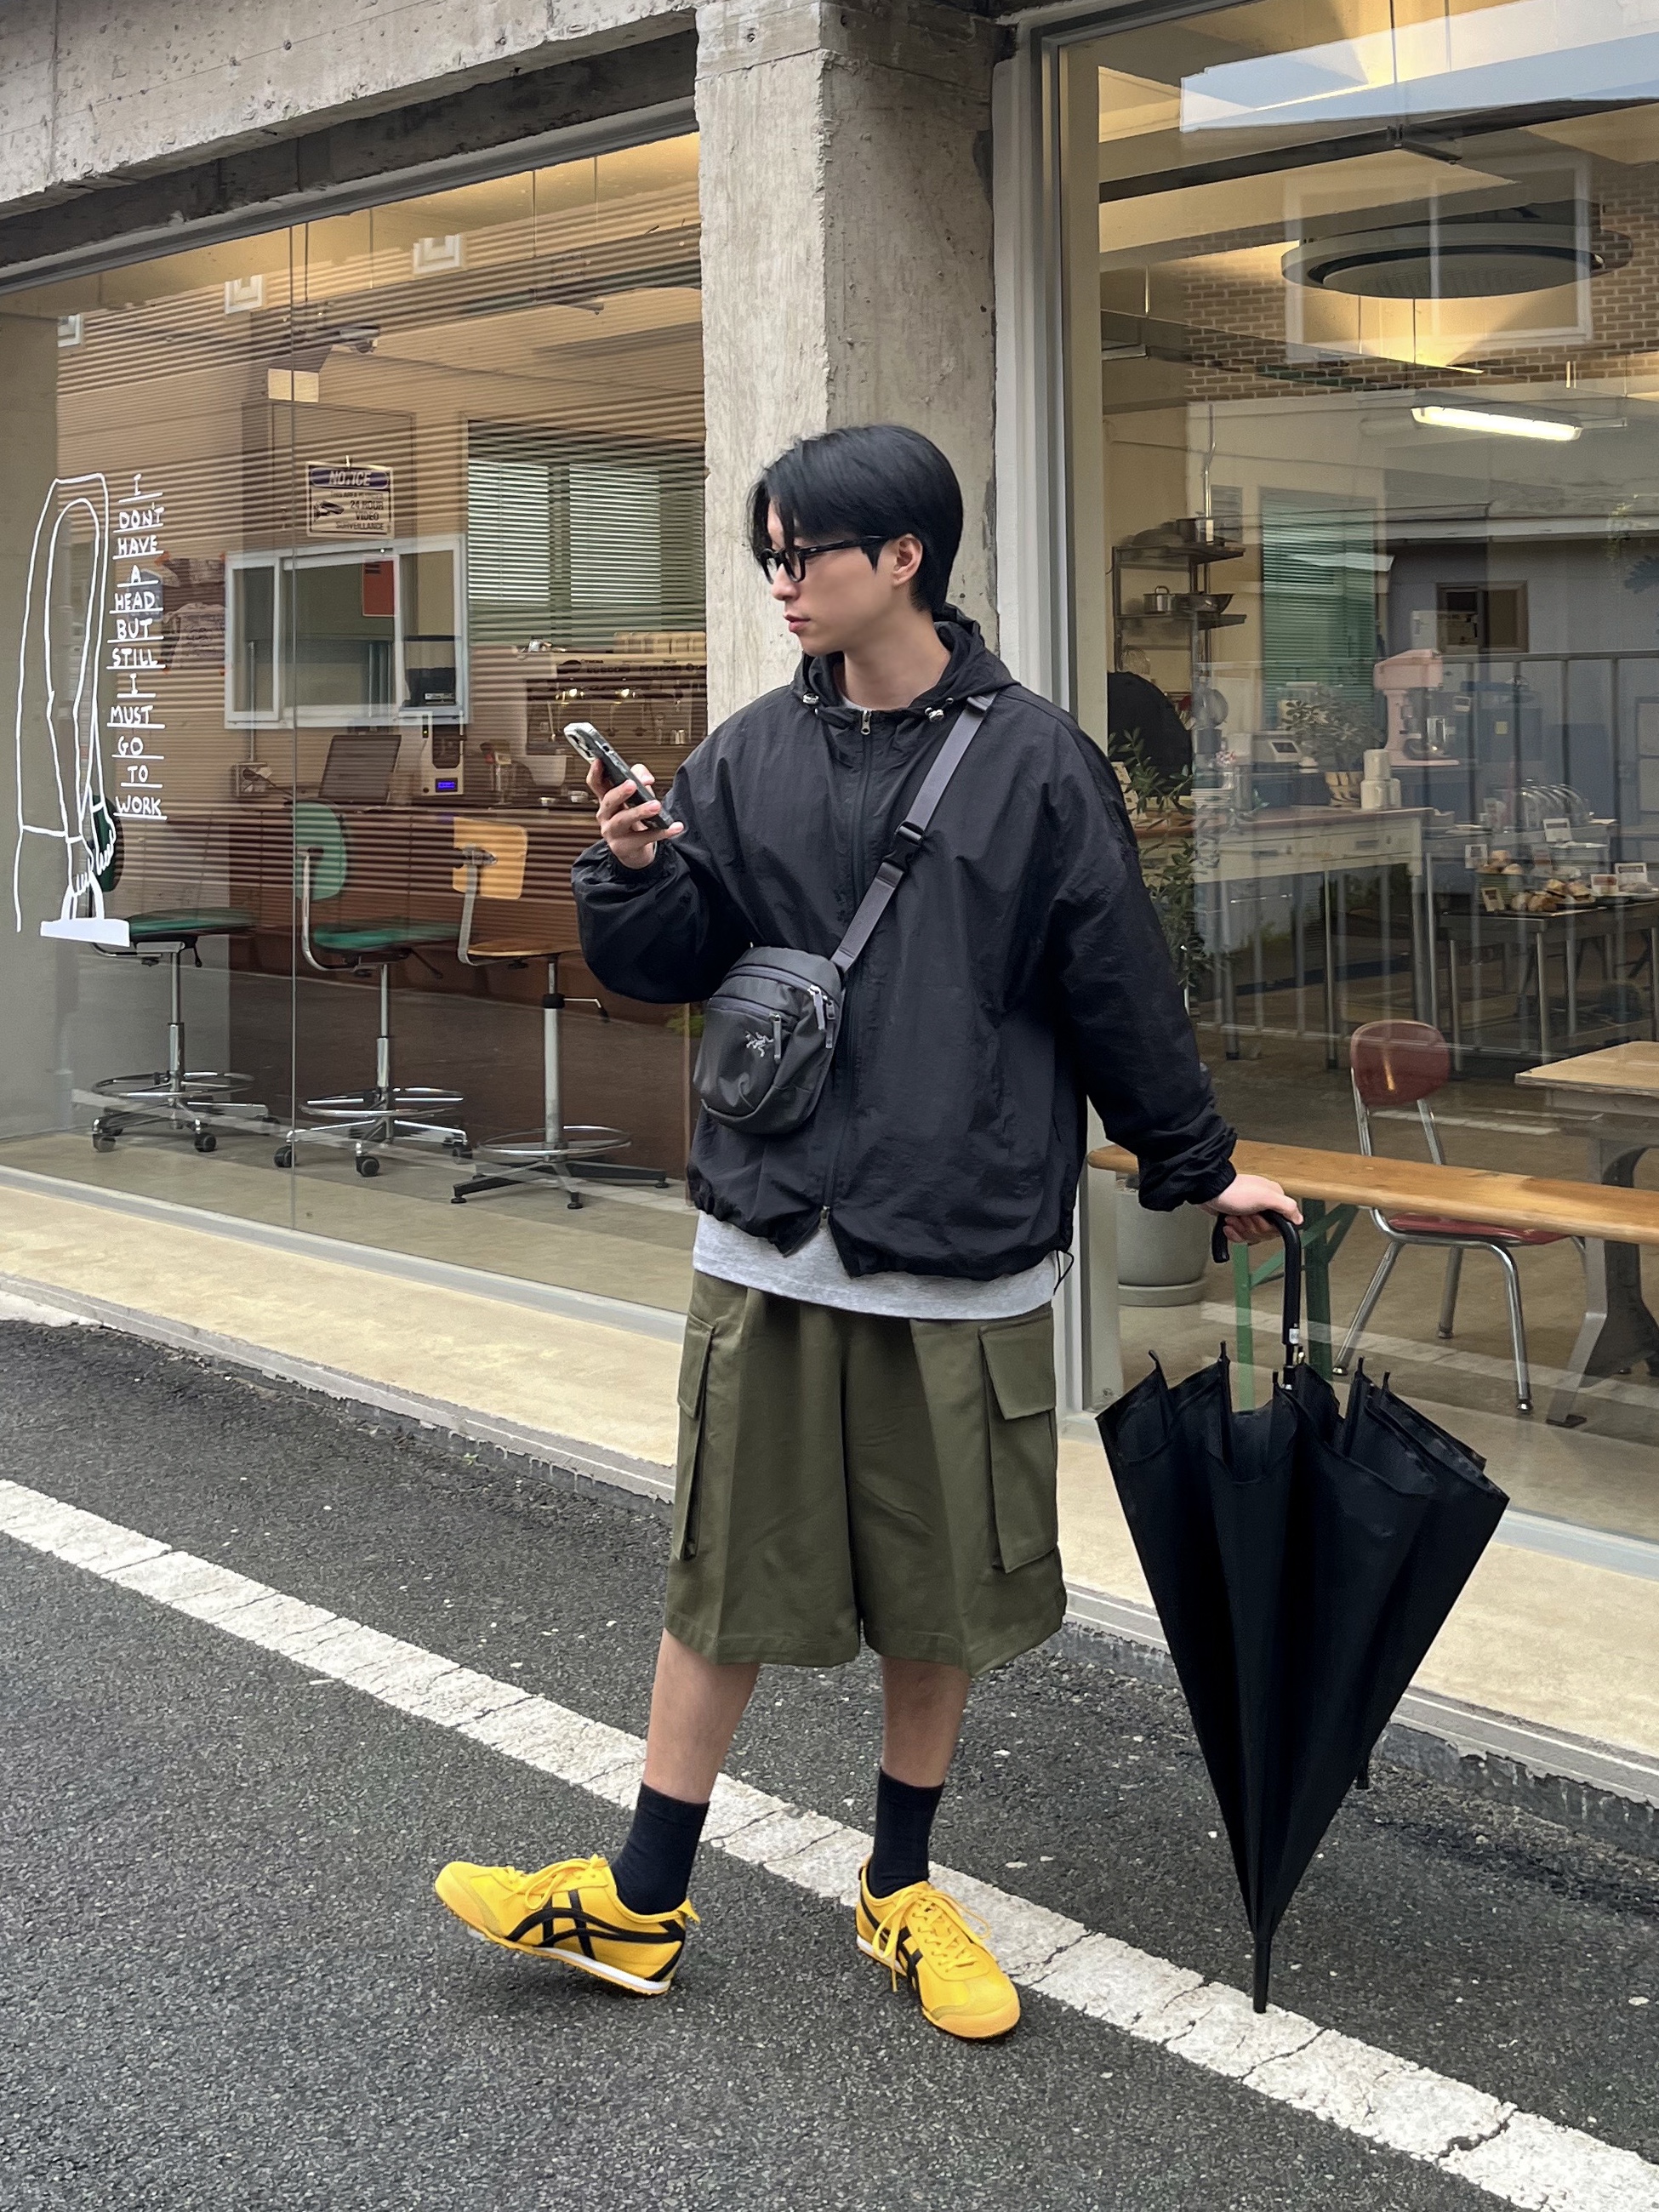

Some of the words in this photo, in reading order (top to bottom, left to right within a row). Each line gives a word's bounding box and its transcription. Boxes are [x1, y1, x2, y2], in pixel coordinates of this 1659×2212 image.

[133, 473, 142, 496] I
[362, 499, 385, 510] HOUR
[118, 502, 165, 529] DON'T
[355, 511, 379, 521] VIDEO
[117, 534, 158, 556] HAVE
[130, 564, 142, 584] A
[114, 591, 156, 612] HEAD
[116, 618, 153, 640] BUT
[111, 647, 158, 668] STILL
[129, 673, 139, 694] I
[110, 704, 154, 725] MUST
[117, 735, 144, 756] GO
[127, 765, 149, 784] TO
[115, 794, 162, 817] WORK
